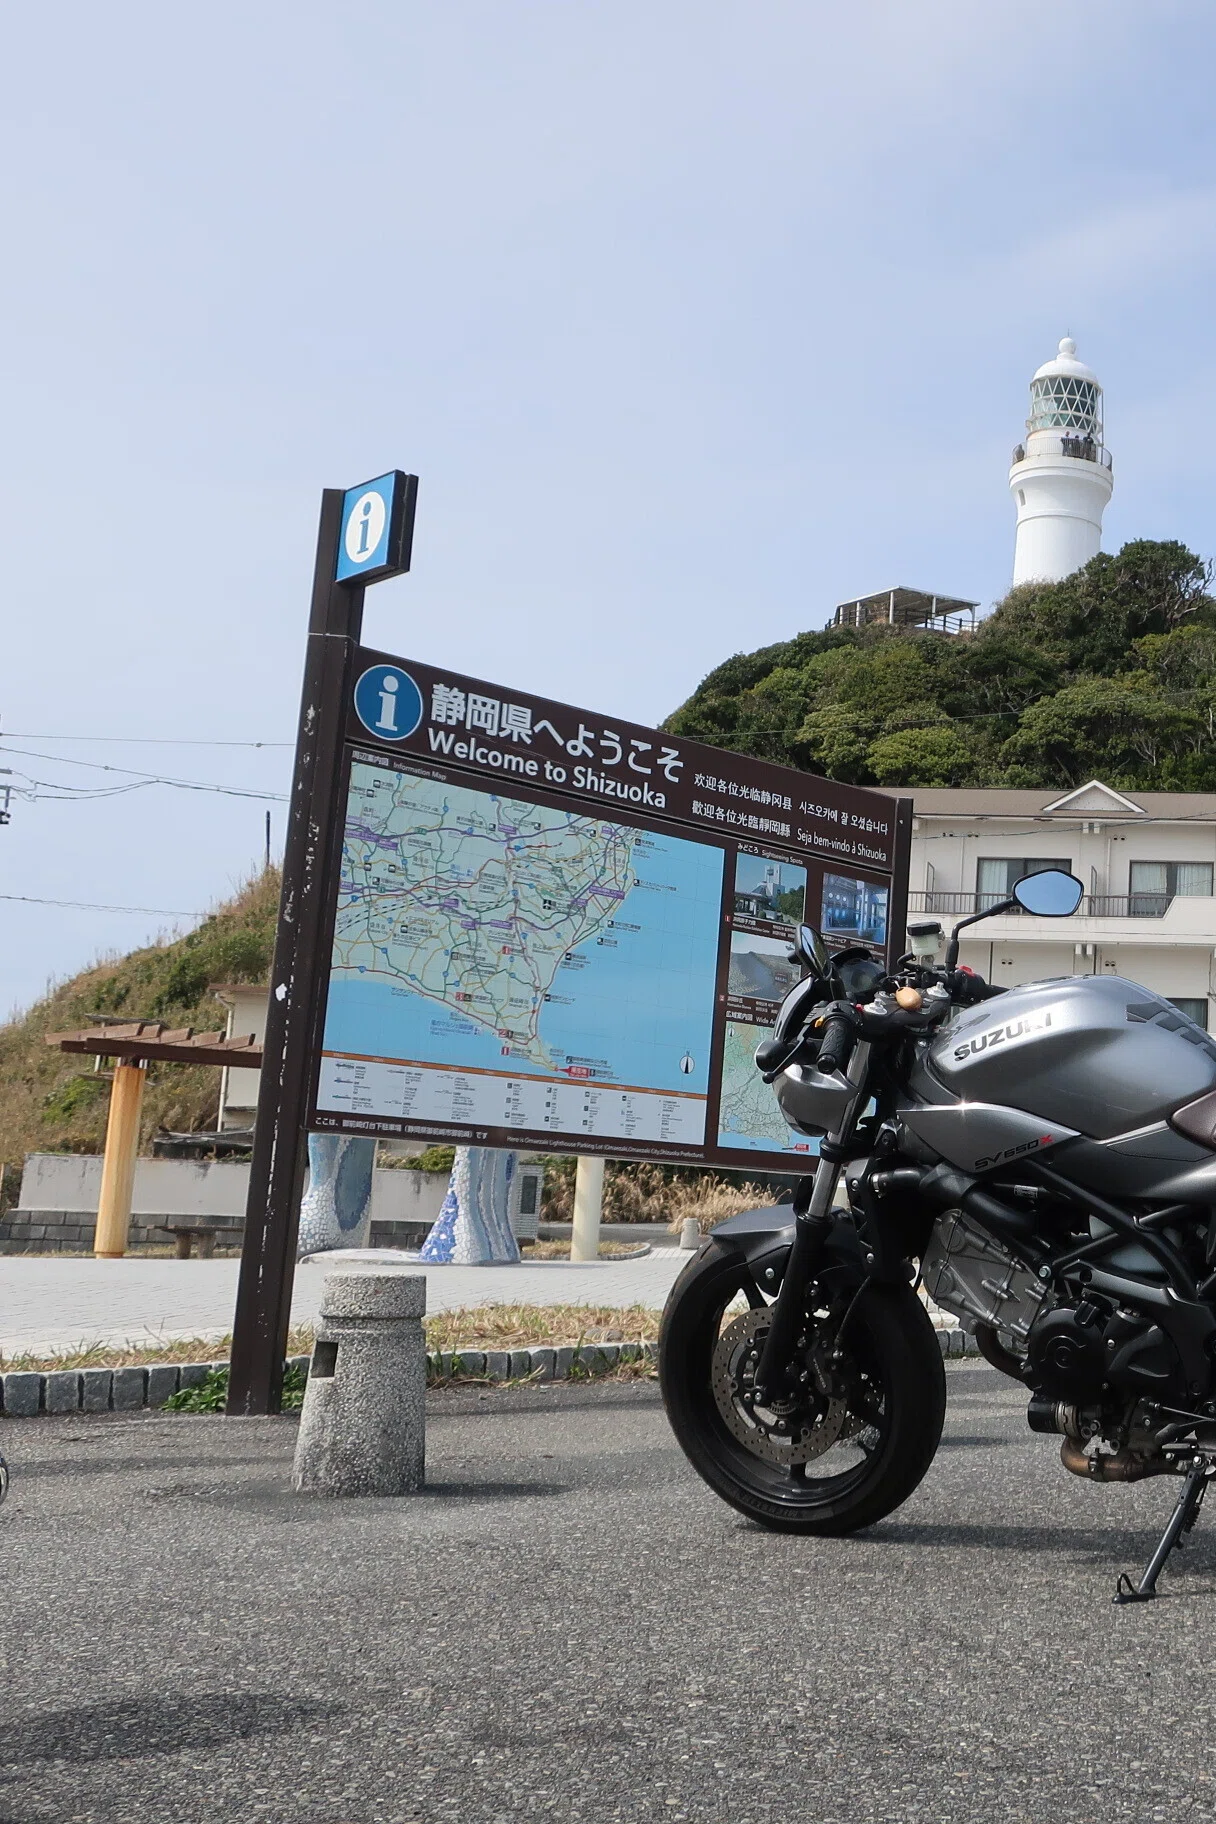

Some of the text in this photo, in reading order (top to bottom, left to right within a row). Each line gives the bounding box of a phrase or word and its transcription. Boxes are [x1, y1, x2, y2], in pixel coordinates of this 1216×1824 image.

[430, 682, 684, 783] 静岡県へようこそ
[393, 761, 447, 781] Information Map
[428, 727, 666, 809] Welcome to Shizuoka
[693, 773, 793, 811] 欢迎各位光临静冈县
[798, 801, 889, 836] 시즈오카에 잘 오셨습니다
[737, 842, 759, 854] みどころ
[789, 856, 804, 865] Spots
[796, 828, 812, 846] Seja
[813, 831, 851, 853] bem-vindo
[857, 843, 887, 862] Shizuoka
[755, 1016, 769, 1024] Wide
[953, 1012, 1052, 1062] SUZUKI
